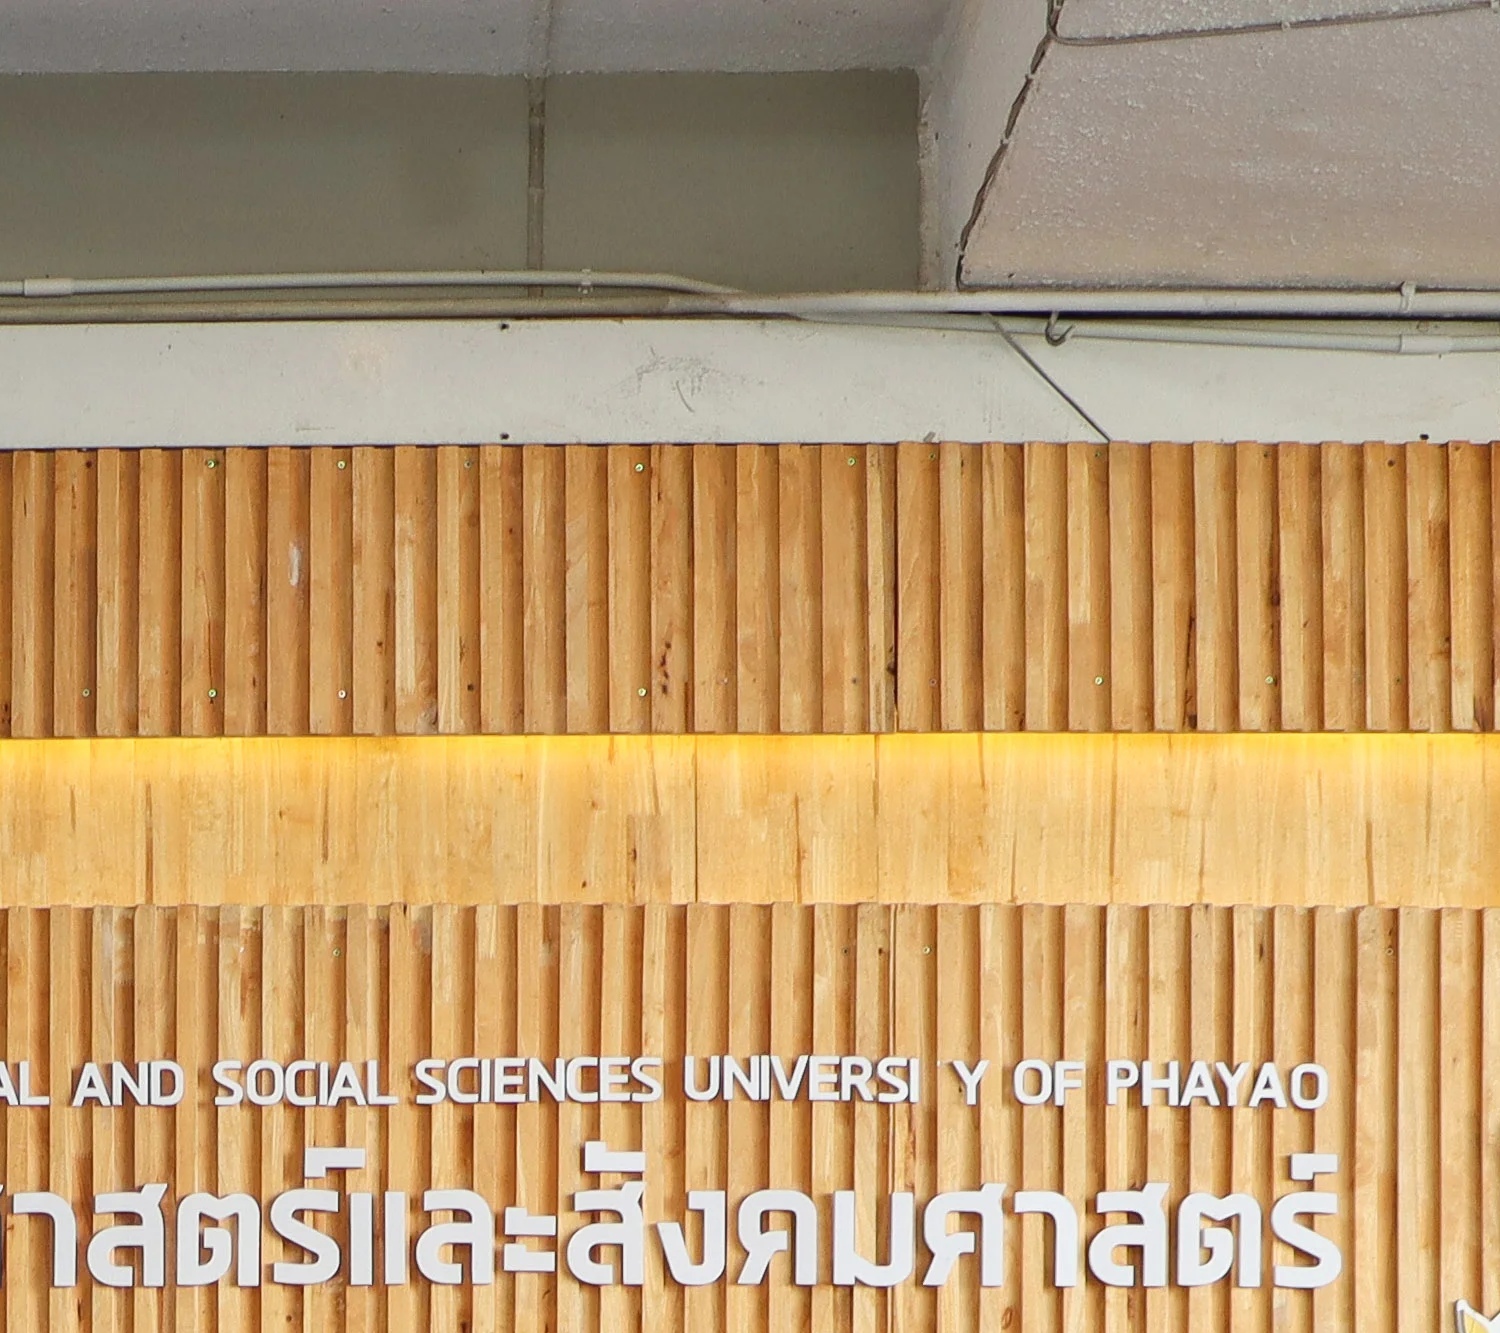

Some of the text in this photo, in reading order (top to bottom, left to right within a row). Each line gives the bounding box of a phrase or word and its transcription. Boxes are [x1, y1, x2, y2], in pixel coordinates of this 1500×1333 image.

[73, 1060, 185, 1107] AND
[212, 1059, 399, 1107] SOCIAL
[415, 1056, 662, 1105] SCIENCES
[1013, 1059, 1085, 1106] OF
[1107, 1059, 1330, 1110] PHAYAO
